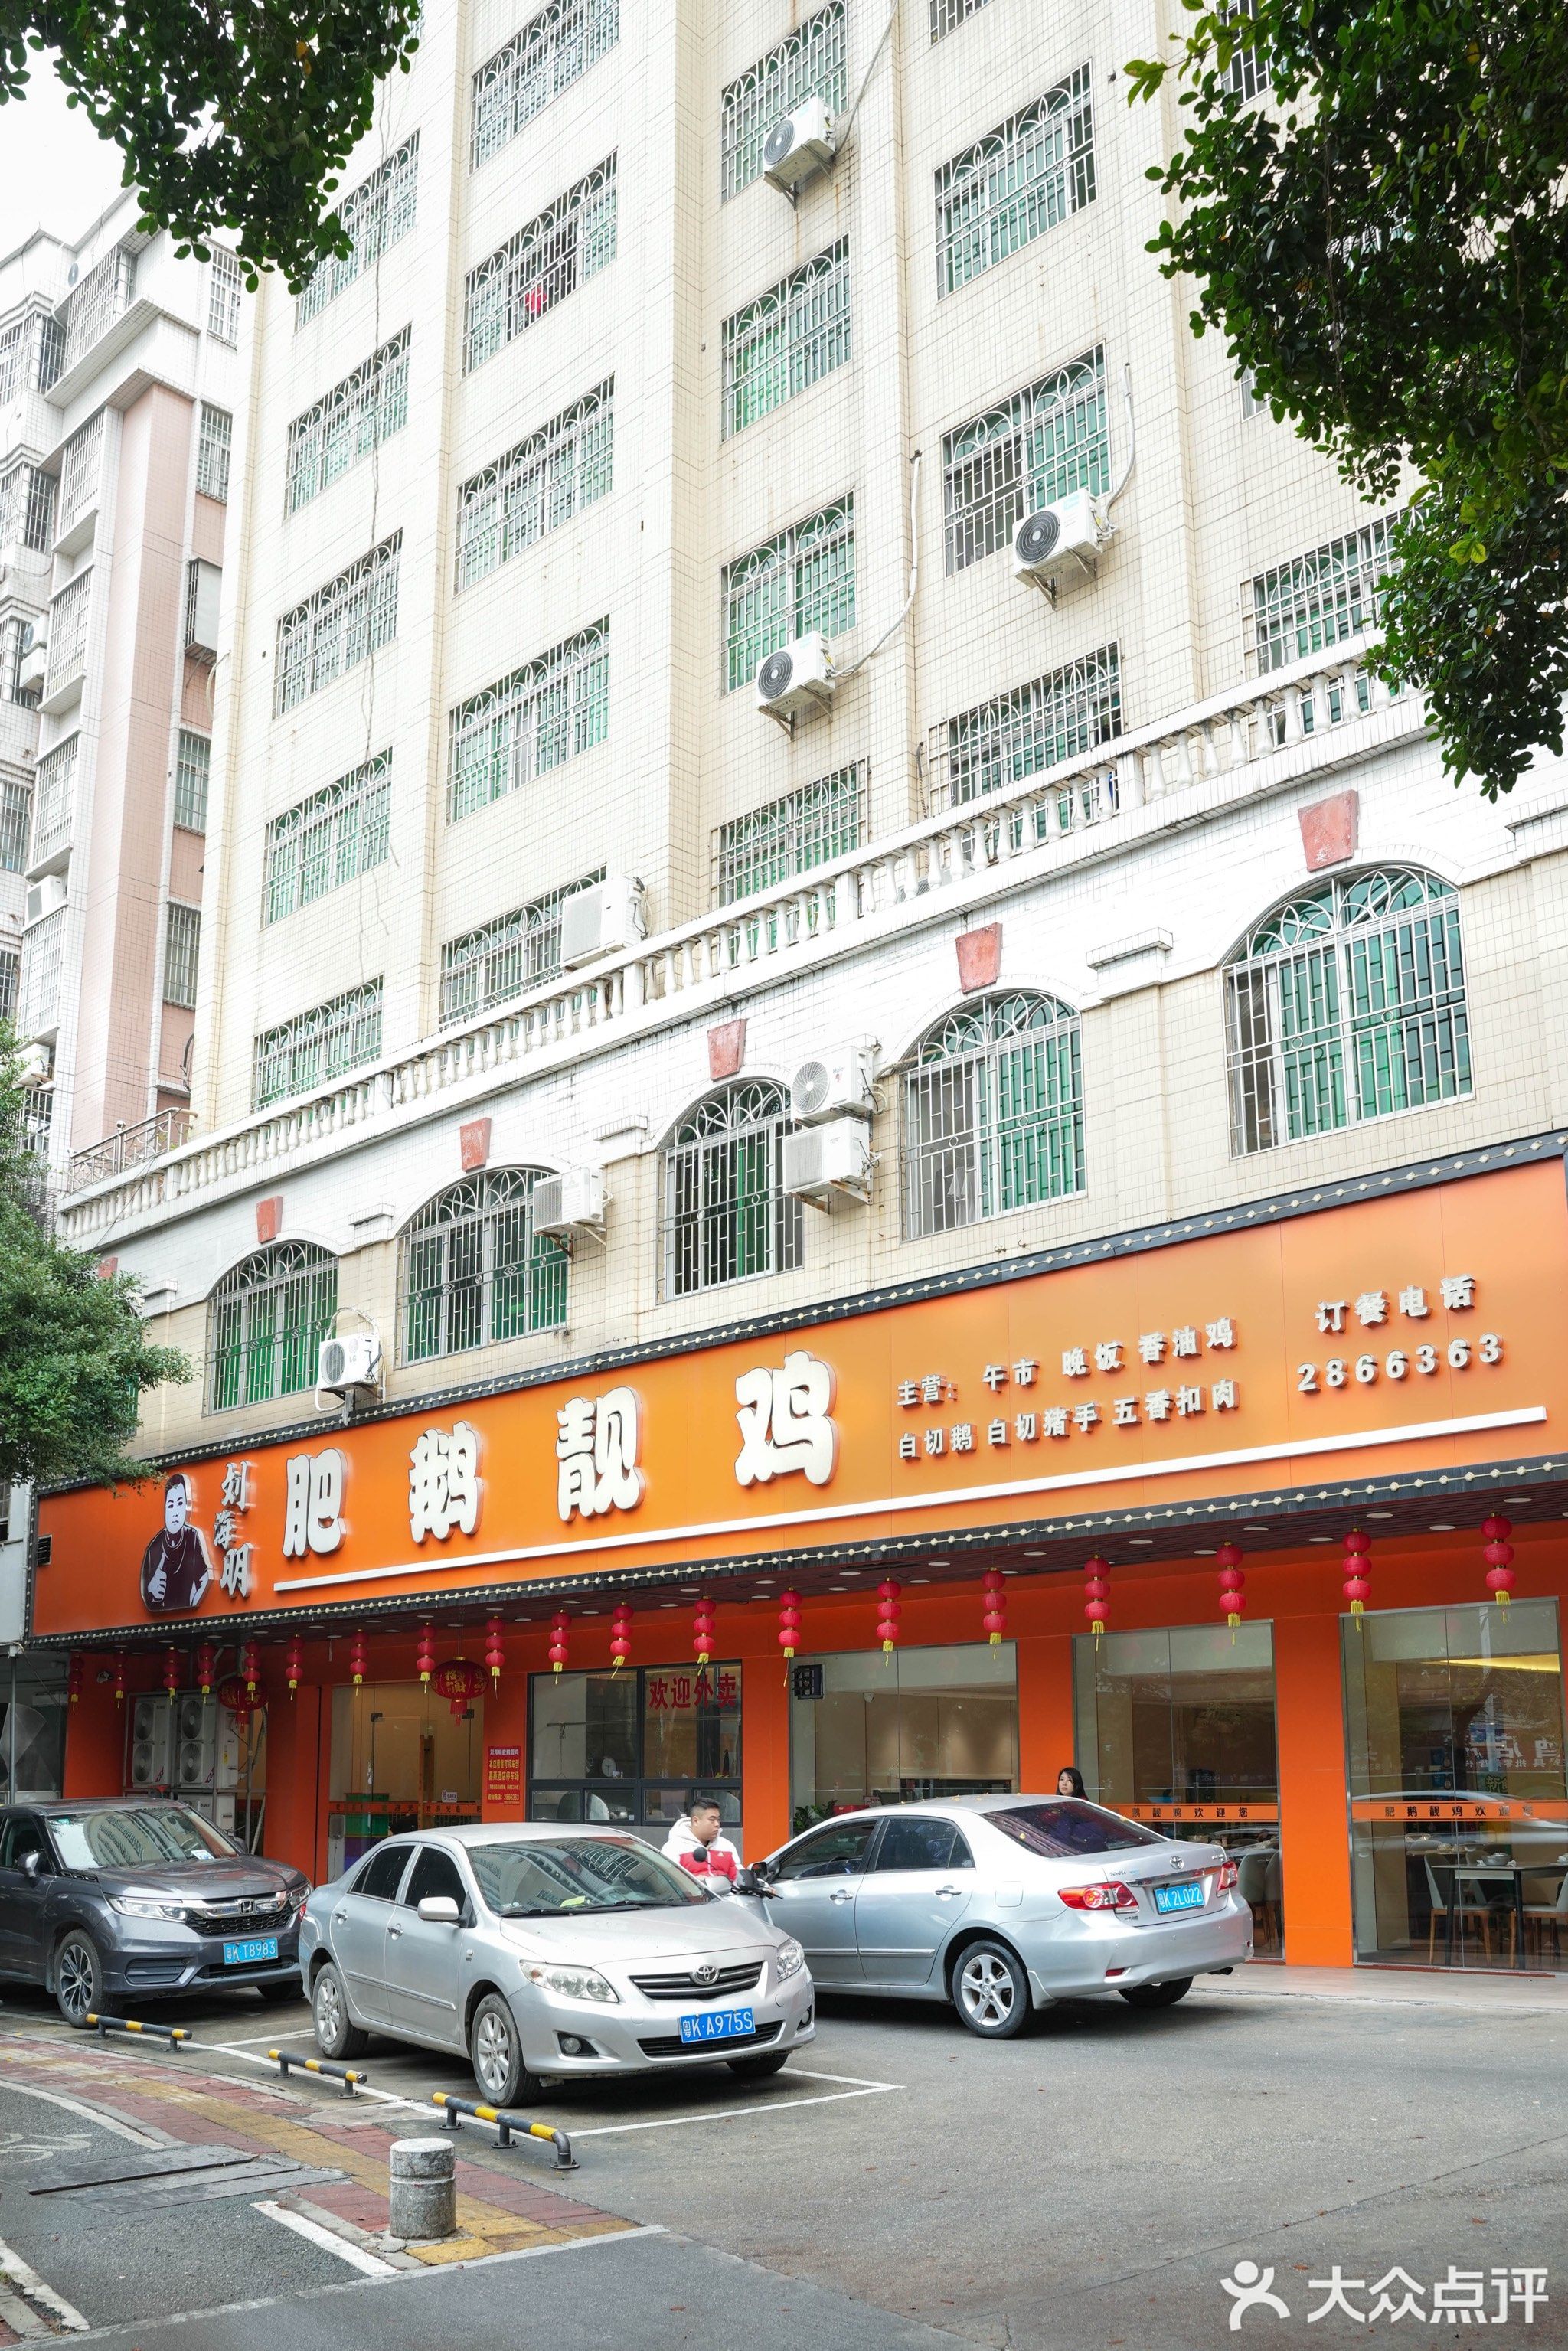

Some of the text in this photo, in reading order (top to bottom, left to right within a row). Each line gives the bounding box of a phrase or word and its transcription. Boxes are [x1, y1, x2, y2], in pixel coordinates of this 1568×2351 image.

[1315, 1273, 1476, 1334] 订餐电话
[982, 1357, 1040, 1393] 午市
[1062, 1341, 1125, 1377] 晚饭
[1138, 1317, 1237, 1366] 香油鸡
[1297, 1332, 1504, 1393] 2866363
[899, 1379, 1240, 1460] 白切鹅 白切猪手 五香扣肉
[283, 1350, 839, 1557] 肥鹅靓鸡
[648, 1673, 737, 1710] 欢迎外卖
[1384, 1805, 1534, 1817] 肥鹅靓鸡欢迎您
